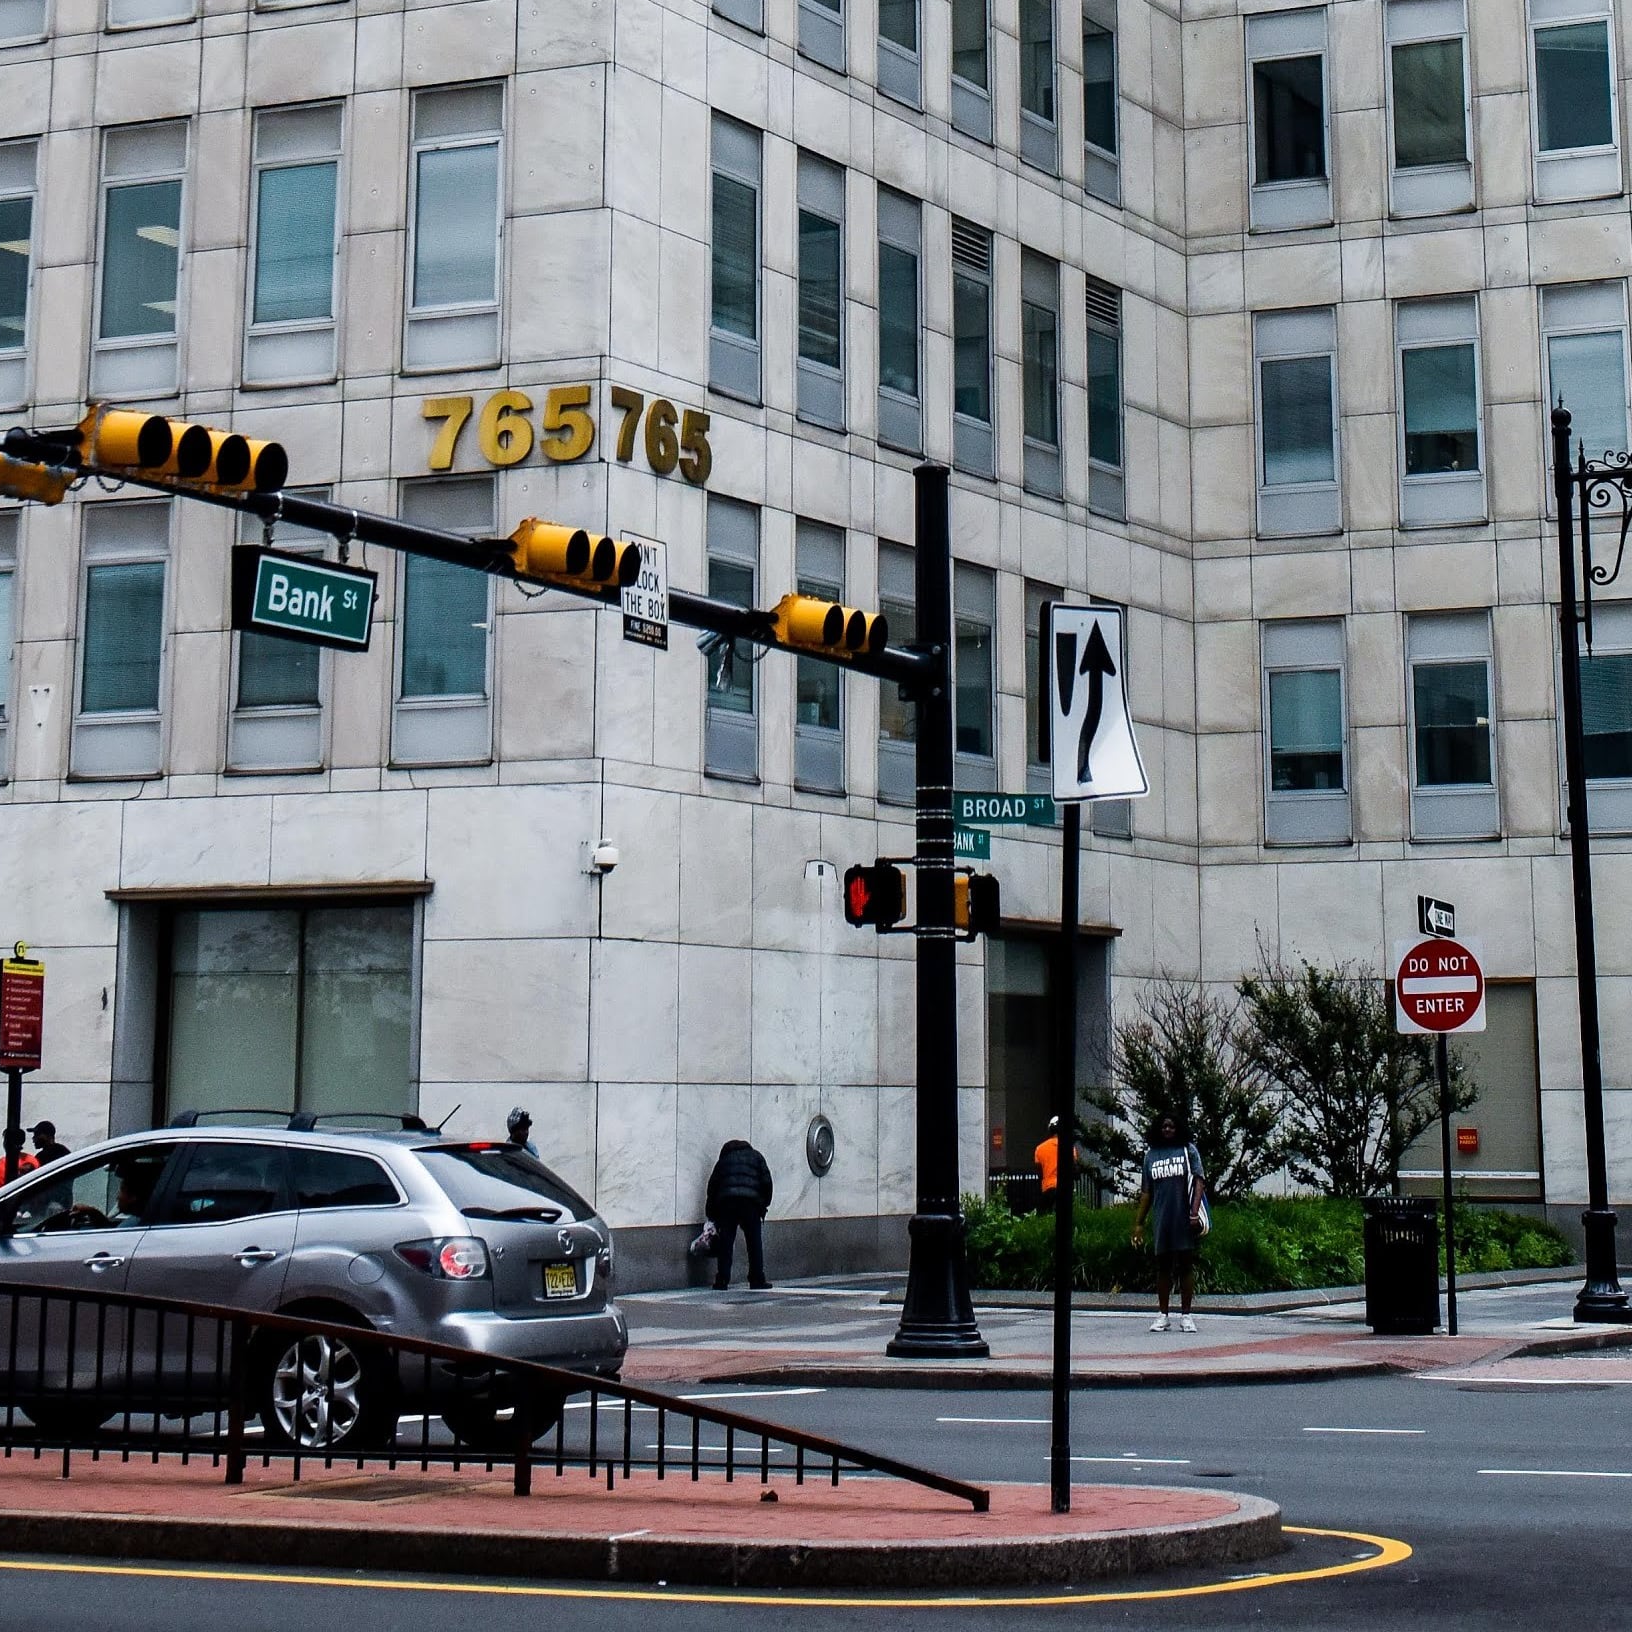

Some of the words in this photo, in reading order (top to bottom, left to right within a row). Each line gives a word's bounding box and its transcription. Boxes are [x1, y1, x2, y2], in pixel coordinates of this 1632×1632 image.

[421, 385, 595, 469] 765
[611, 386, 712, 483] 765
[268, 573, 335, 622] Bank
[342, 589, 358, 610] St
[625, 591, 643, 615] THE
[648, 598, 665, 622] BOX
[963, 799, 1026, 817] BROAD
[1033, 798, 1045, 809] ST
[1409, 958, 1429, 972] DO
[1438, 956, 1469, 971] NOT
[1416, 998, 1465, 1014] ENTER
[1151, 1163, 1184, 1180] DRAMA
